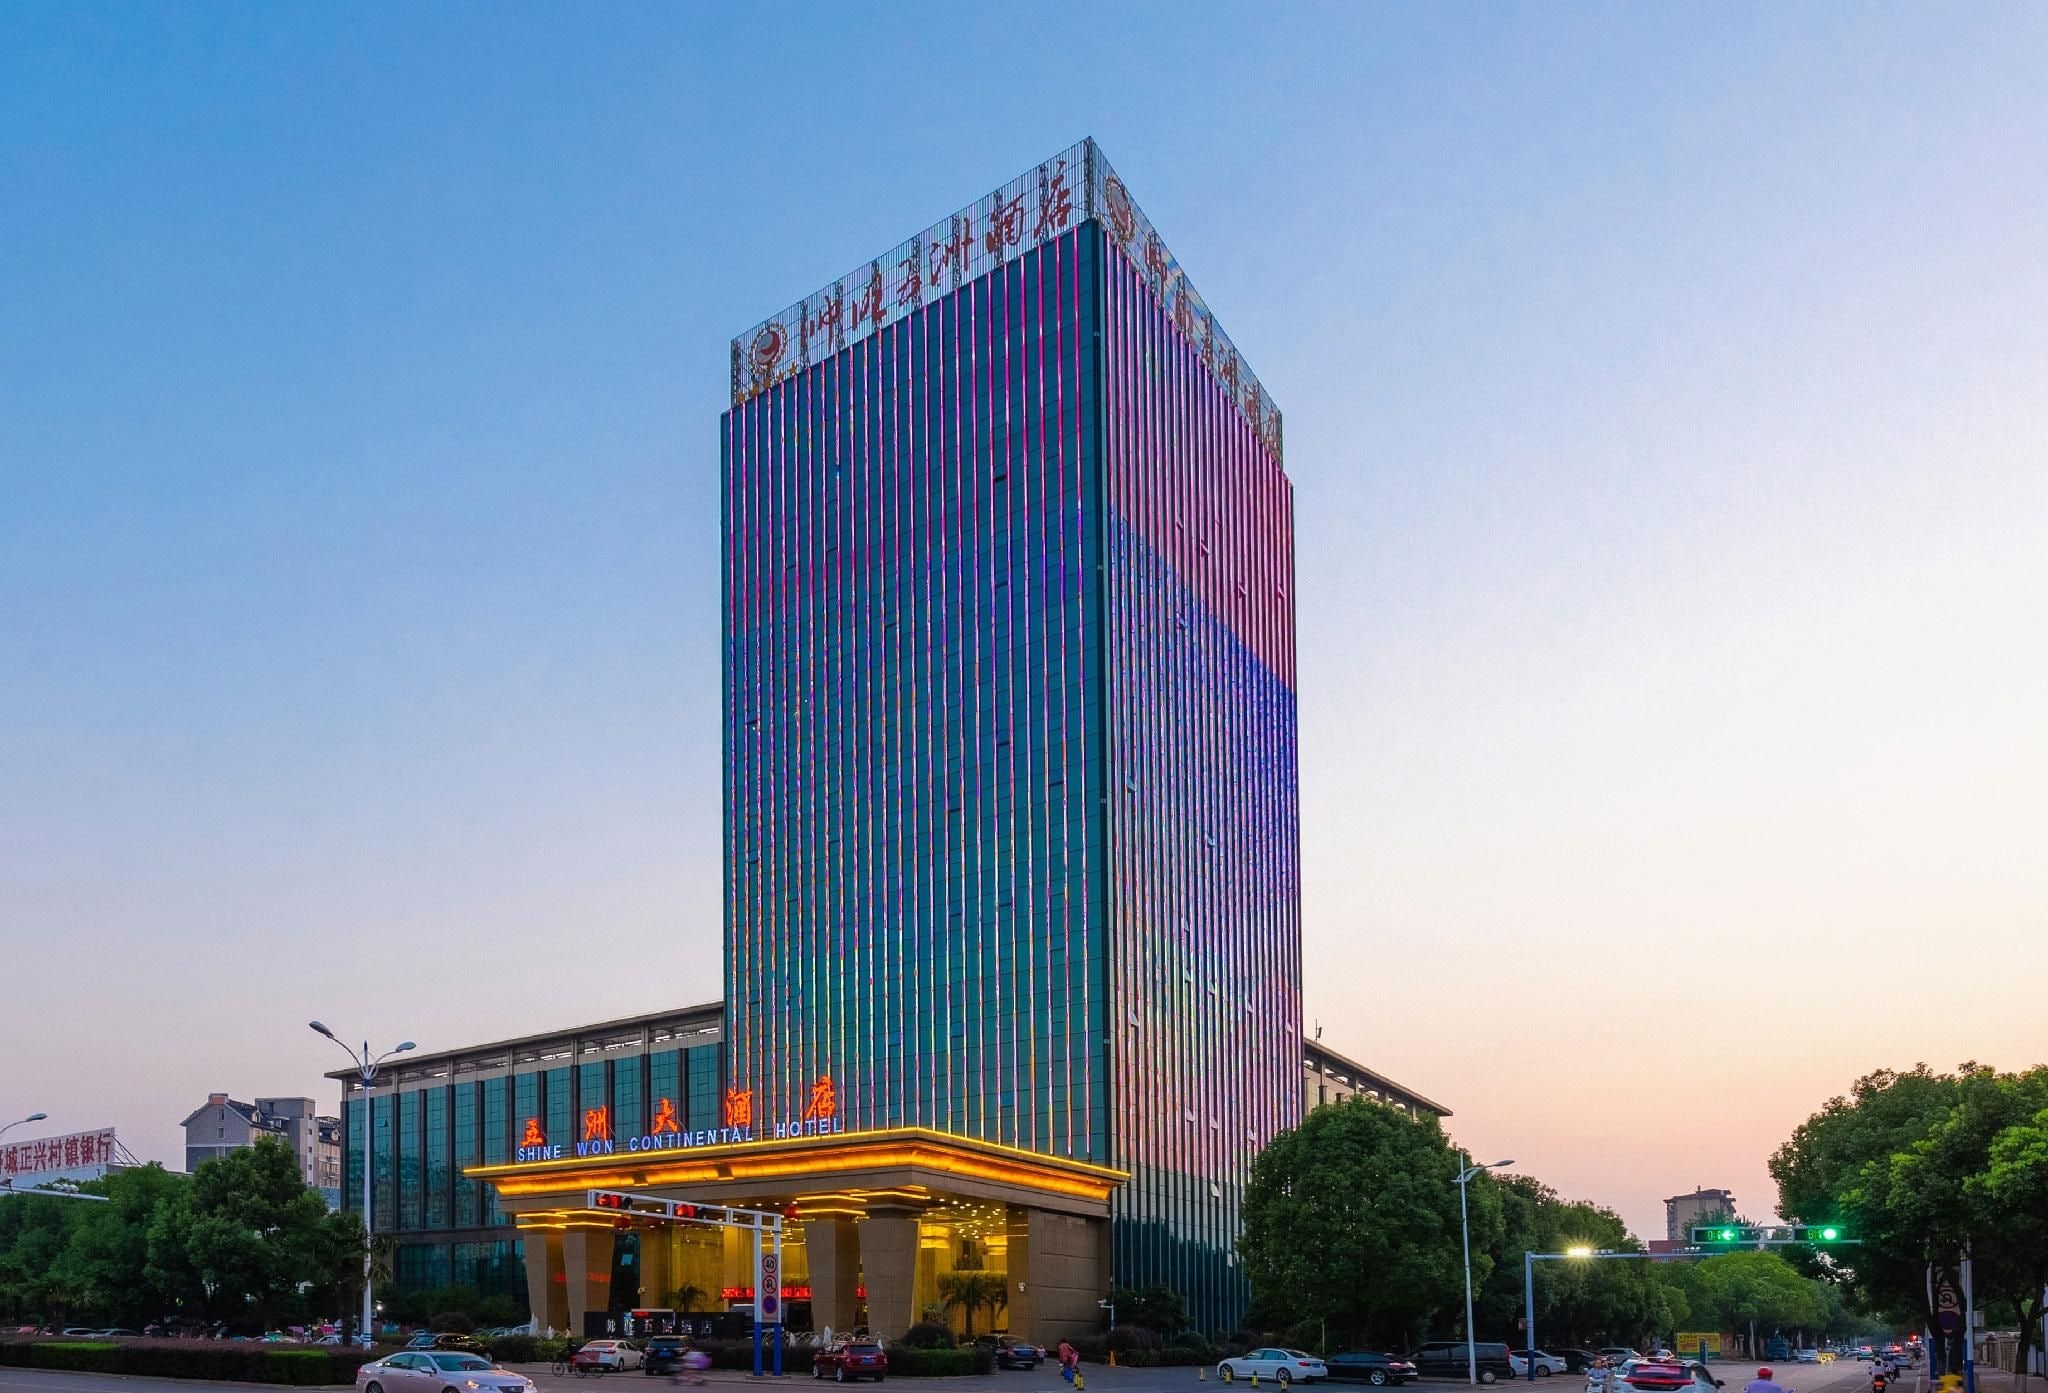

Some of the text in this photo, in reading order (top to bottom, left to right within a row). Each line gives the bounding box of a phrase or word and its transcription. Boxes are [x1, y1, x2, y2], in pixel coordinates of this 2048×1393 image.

[518, 1118, 843, 1161] SHINE WON CONTINENTAL HOTEL
